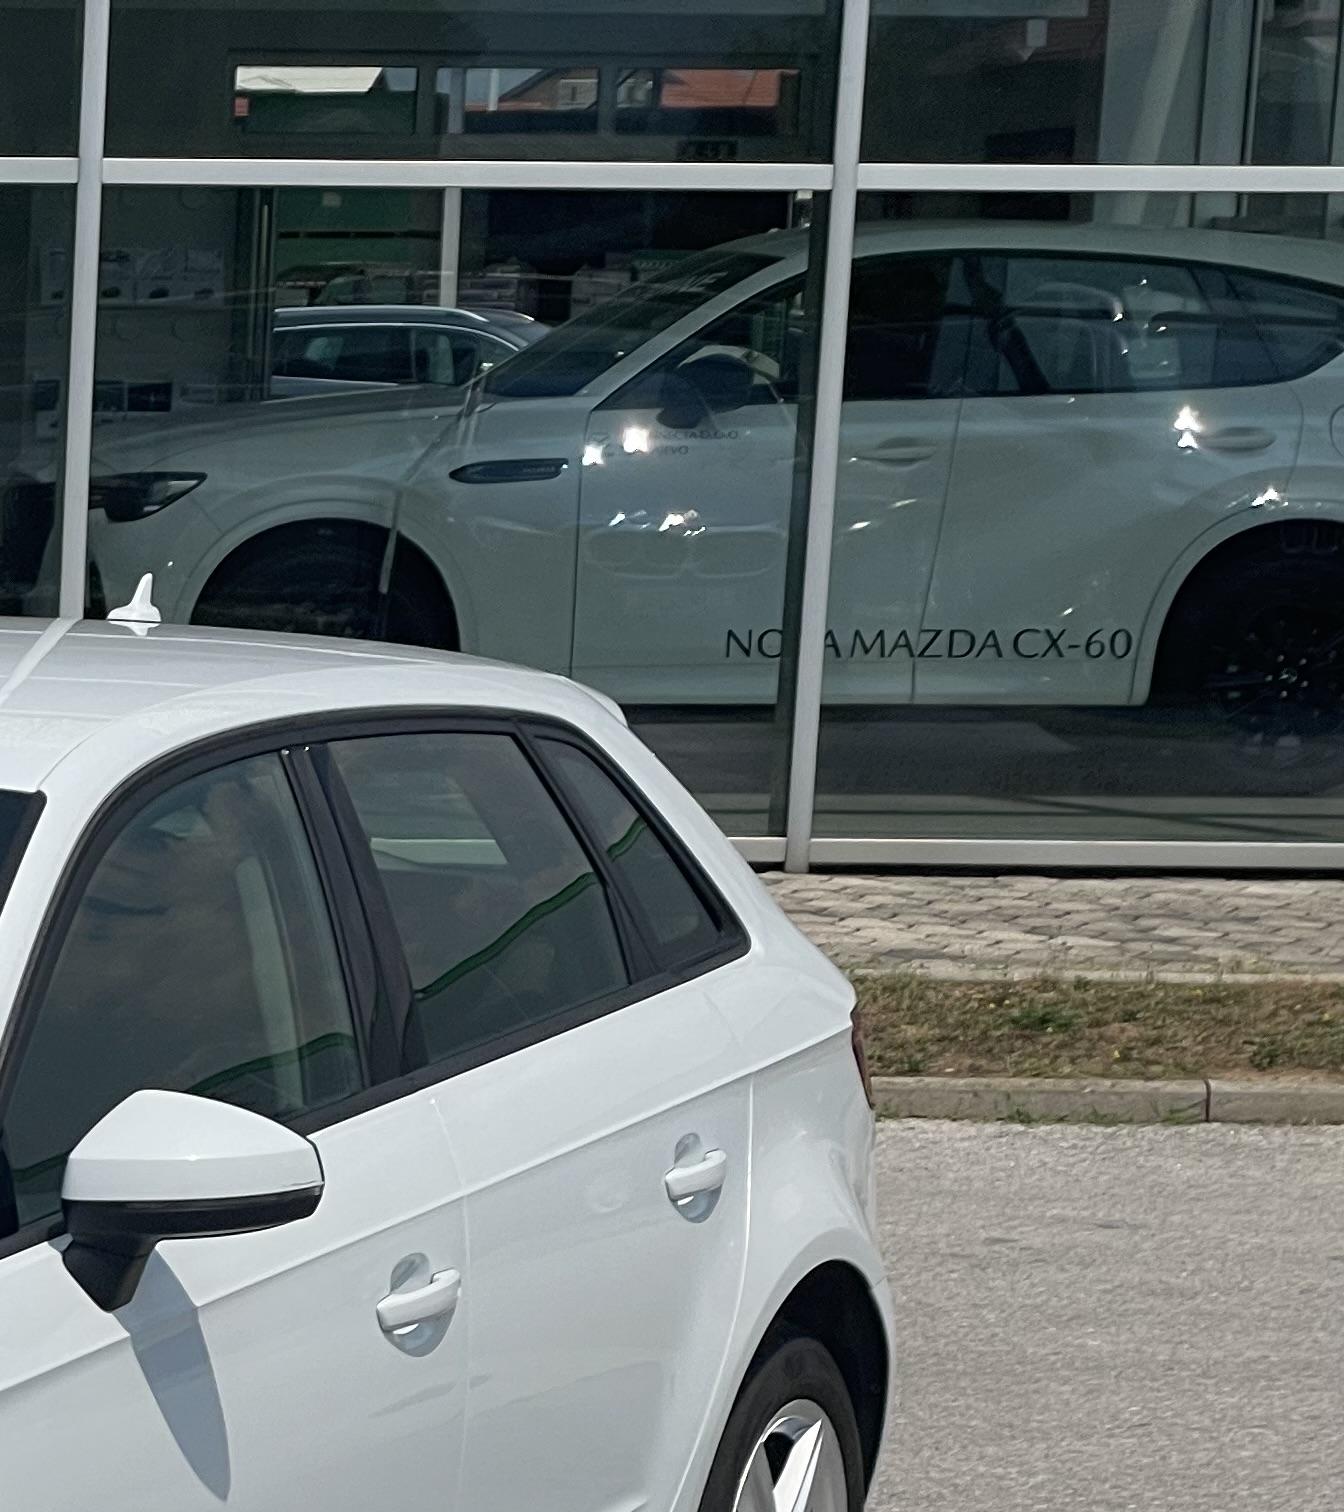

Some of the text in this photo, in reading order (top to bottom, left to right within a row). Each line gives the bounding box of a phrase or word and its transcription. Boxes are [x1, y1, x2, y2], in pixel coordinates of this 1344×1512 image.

[726, 628, 1133, 659] NOA MAZDA CX-60
